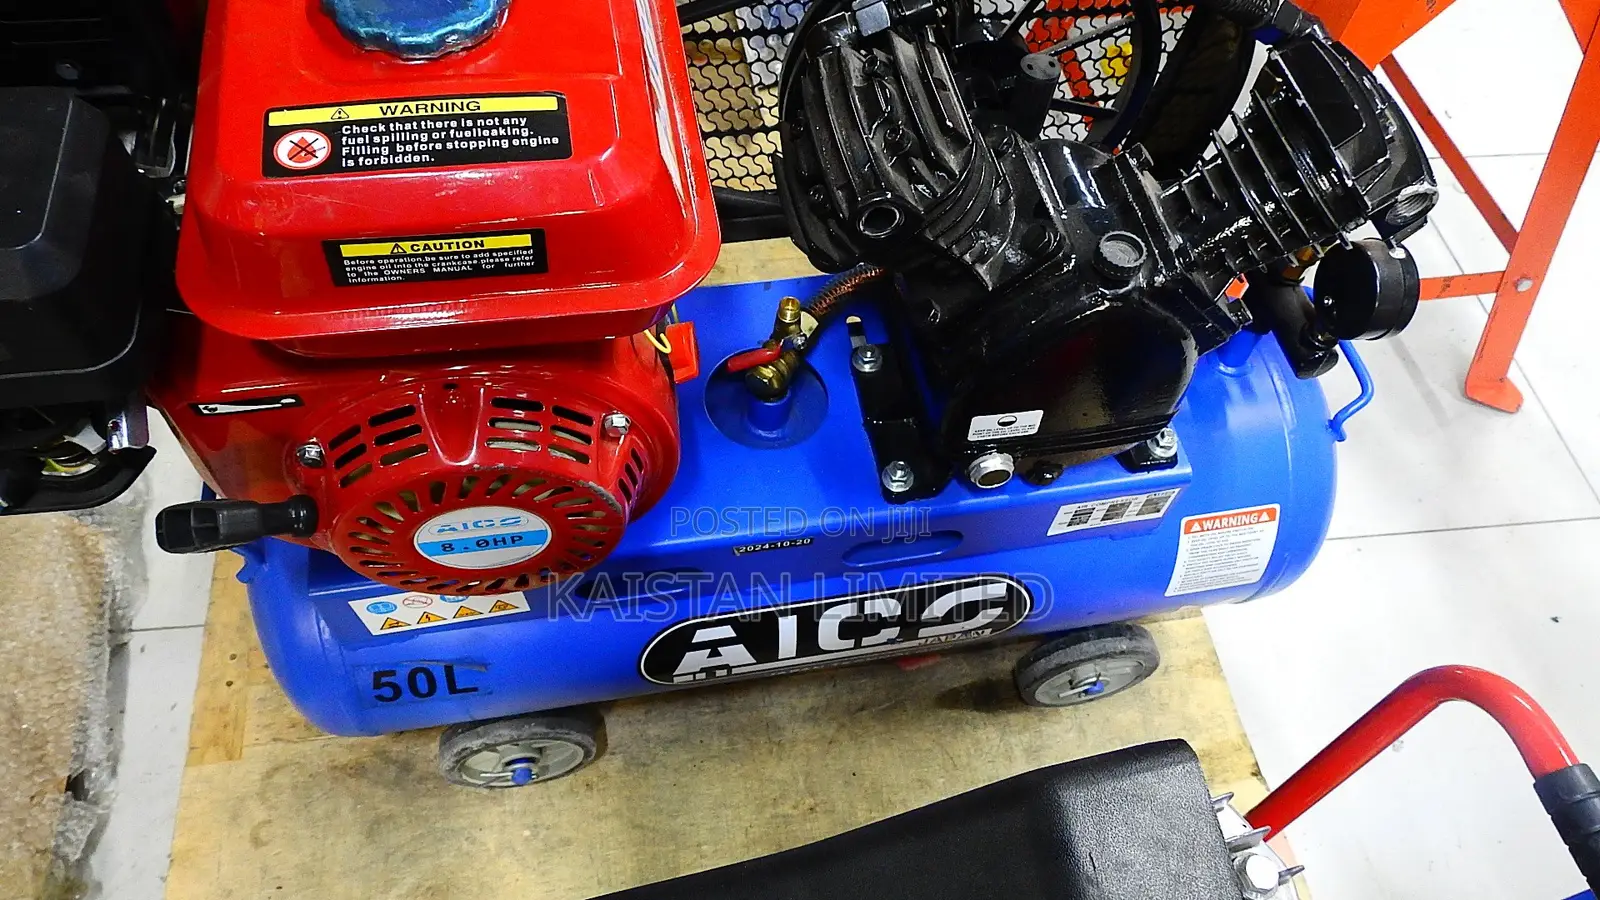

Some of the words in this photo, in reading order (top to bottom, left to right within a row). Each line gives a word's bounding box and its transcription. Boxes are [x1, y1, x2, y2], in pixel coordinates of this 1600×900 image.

[380, 101, 481, 116] WARNING
[342, 122, 386, 135] Check
[390, 120, 421, 131] that
[421, 119, 457, 130] there
[461, 118, 473, 127] is
[477, 117, 499, 127] not
[503, 116, 527, 127] any
[342, 134, 369, 145] fuel
[373, 131, 428, 144] spilling
[432, 131, 446, 139] or
[342, 145, 389, 156] Filling
[396, 142, 442, 152] before
[446, 137, 509, 150] stopping
[512, 135, 560, 147] engine
[342, 157, 355, 168] is
[359, 154, 435, 166] forbidden.
[410, 240, 485, 252] CAUTION
[492, 249, 534, 258] specified
[433, 265, 473, 273] MANUAL
[348, 275, 406, 284] information.
[1202, 512, 1258, 531] WARNING
[739, 538, 811, 553] 2024-10-20
[372, 664, 479, 702] 50L
